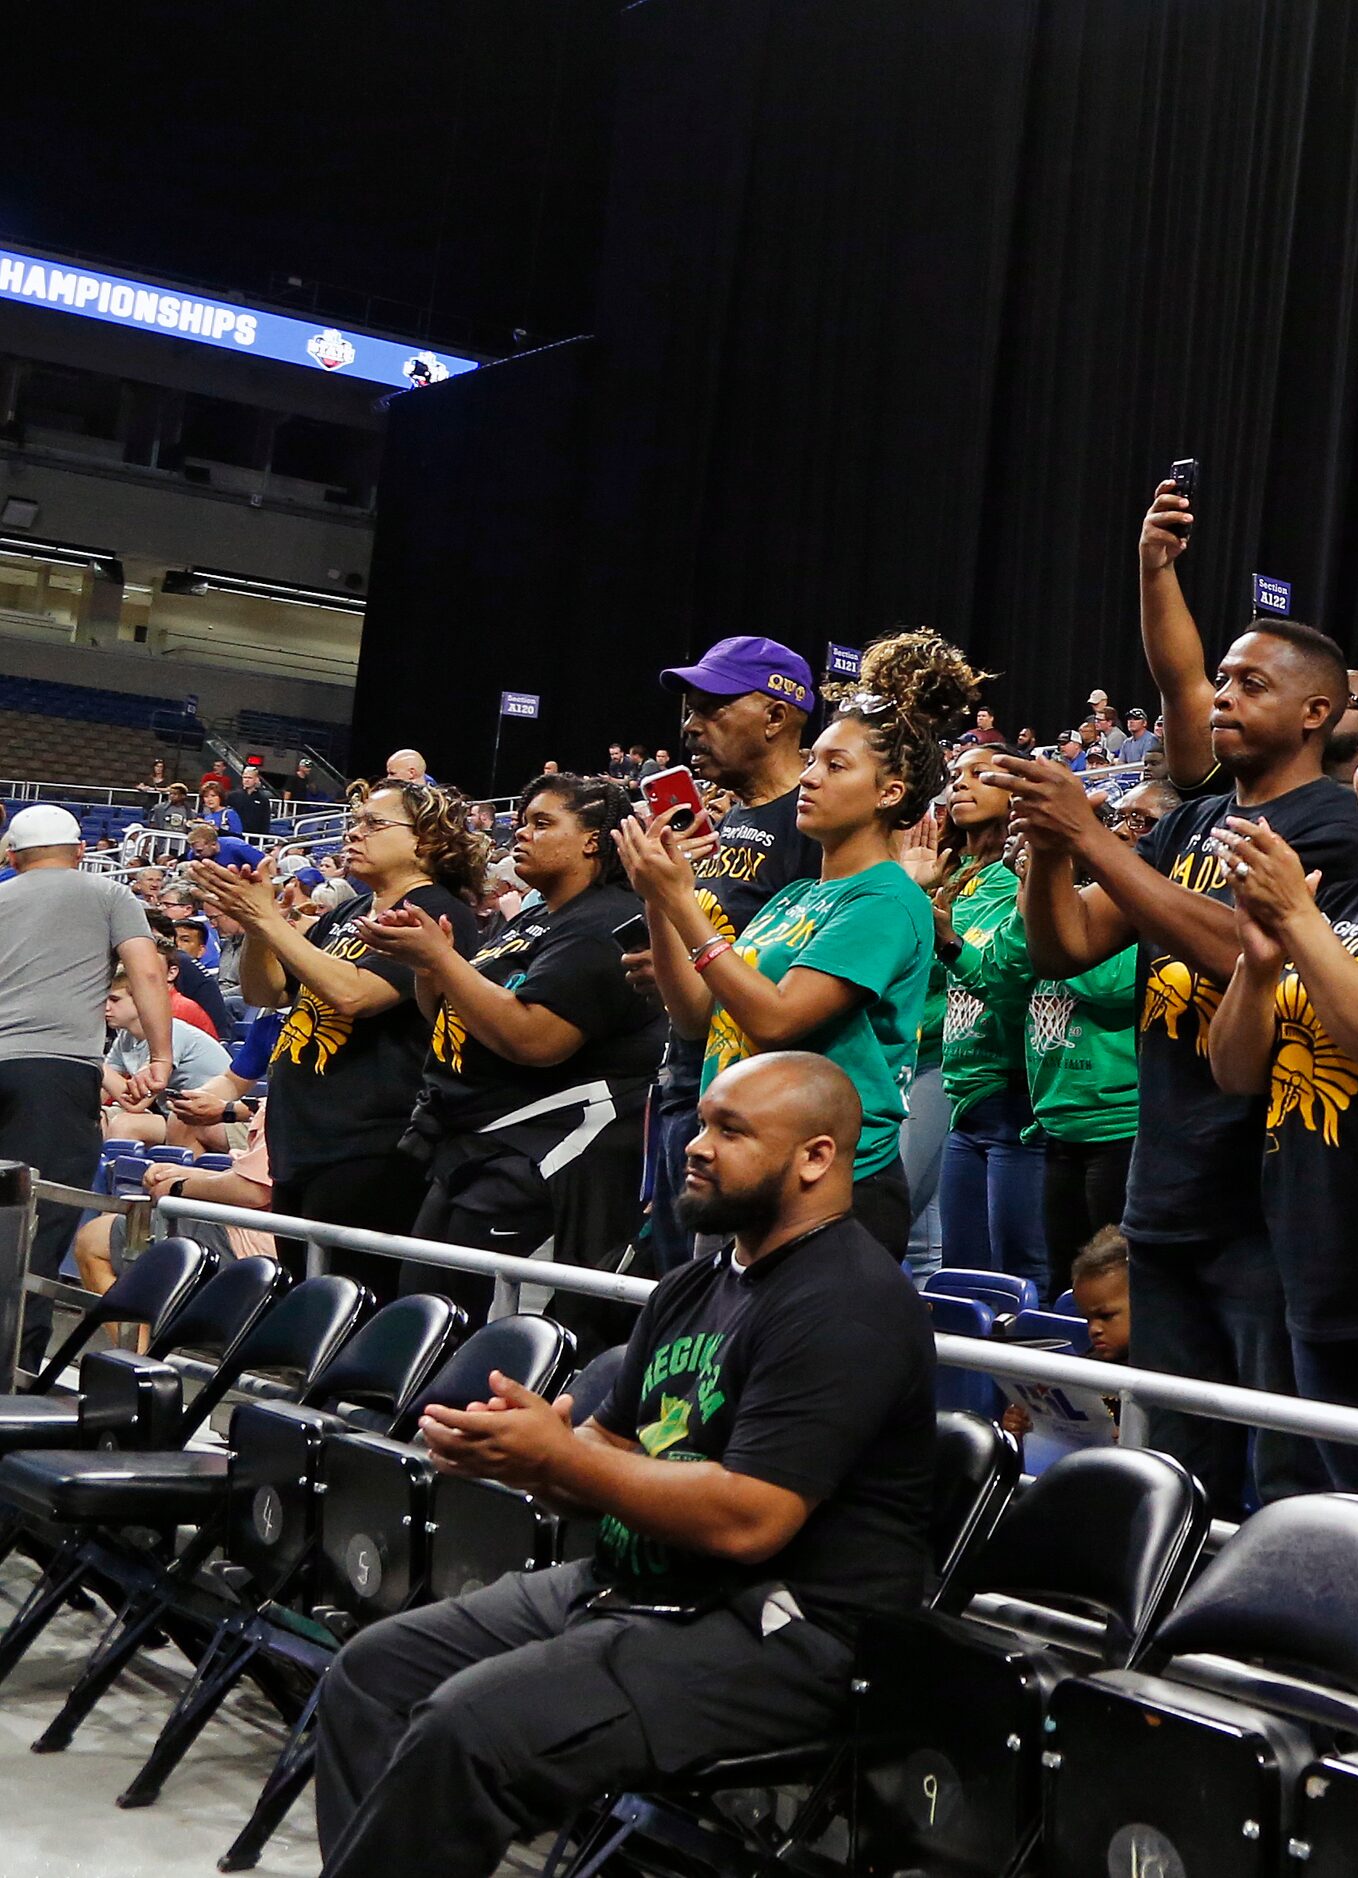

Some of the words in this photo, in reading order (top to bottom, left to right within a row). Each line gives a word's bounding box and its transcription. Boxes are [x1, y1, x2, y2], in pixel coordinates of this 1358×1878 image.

[1259, 578, 1288, 595] Section
[1261, 590, 1286, 610] A122
[833, 647, 859, 661] Section
[834, 657, 857, 673] A121
[507, 694, 537, 705] Section
[508, 703, 535, 715] A120
[262, 1495, 273, 1538] 4
[357, 1550, 370, 1585] 5
[923, 1774, 938, 1826] 9
